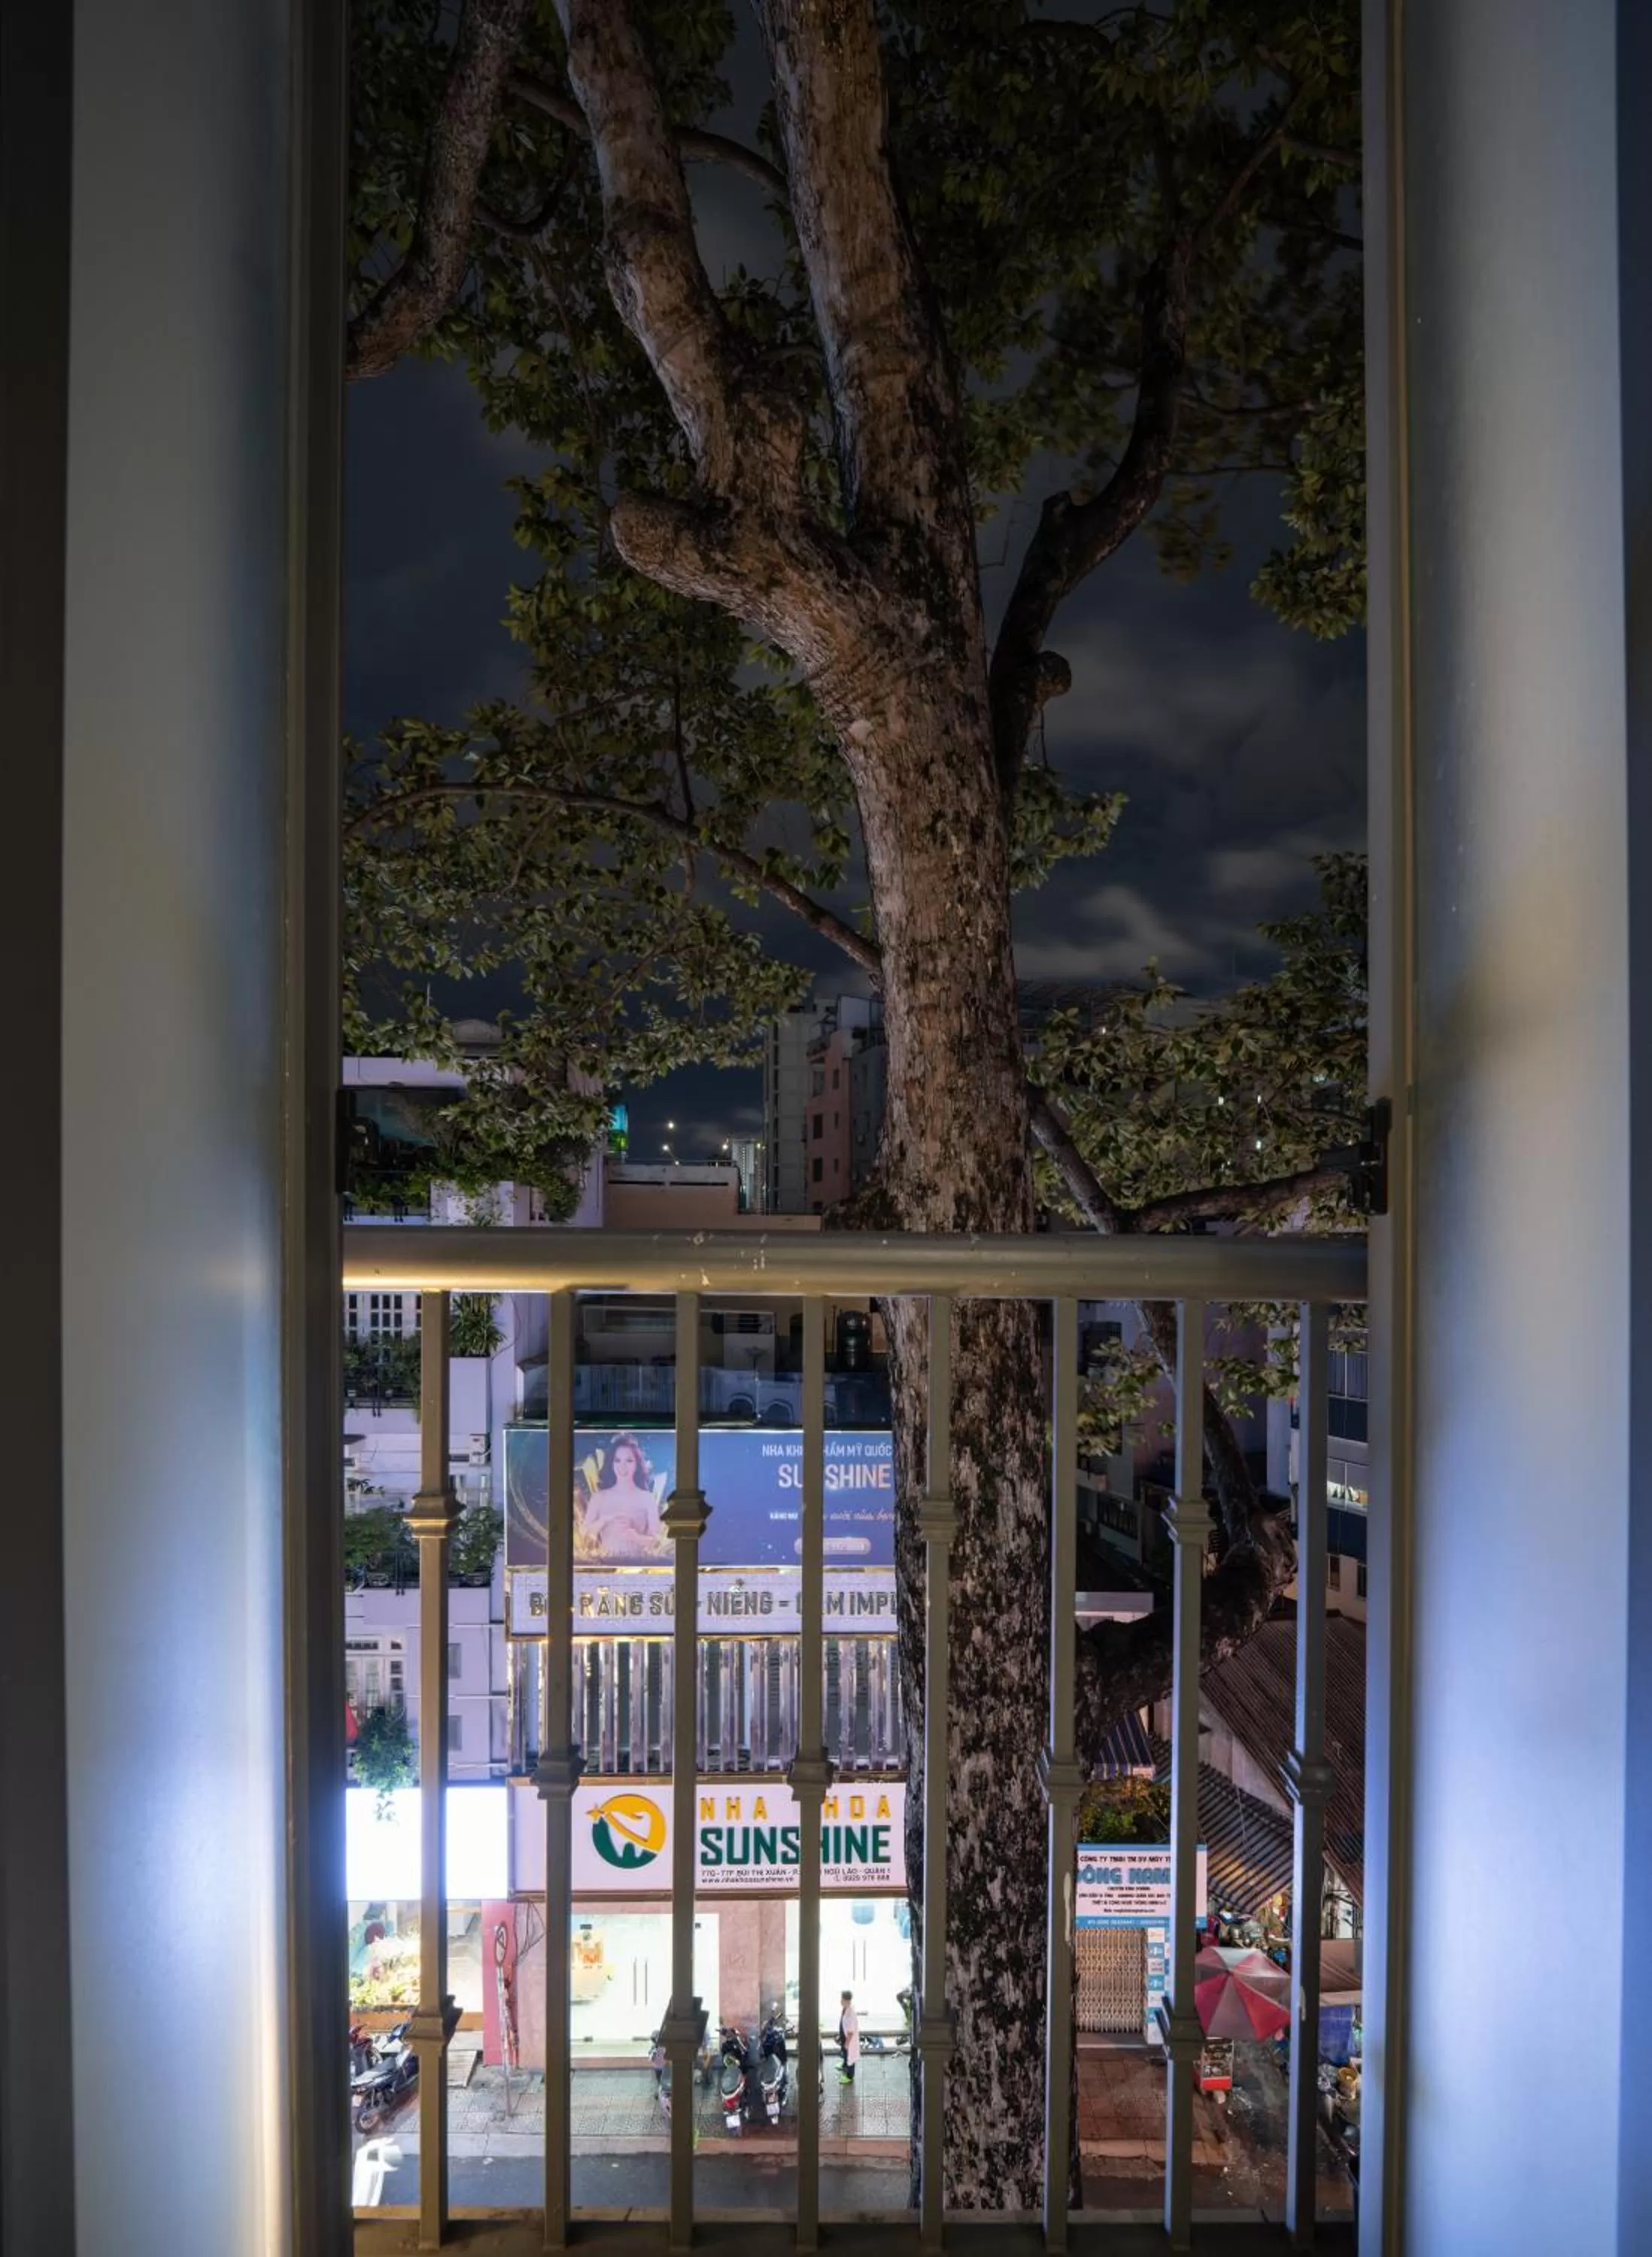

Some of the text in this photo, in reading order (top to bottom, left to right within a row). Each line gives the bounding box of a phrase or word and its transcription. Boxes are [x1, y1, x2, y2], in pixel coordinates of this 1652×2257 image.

[762, 1444, 784, 1457] NHA
[778, 1463, 891, 1490] SUSHINE
[580, 1585, 642, 1617] RĂNG
[700, 1794, 891, 1821] NHA HOA
